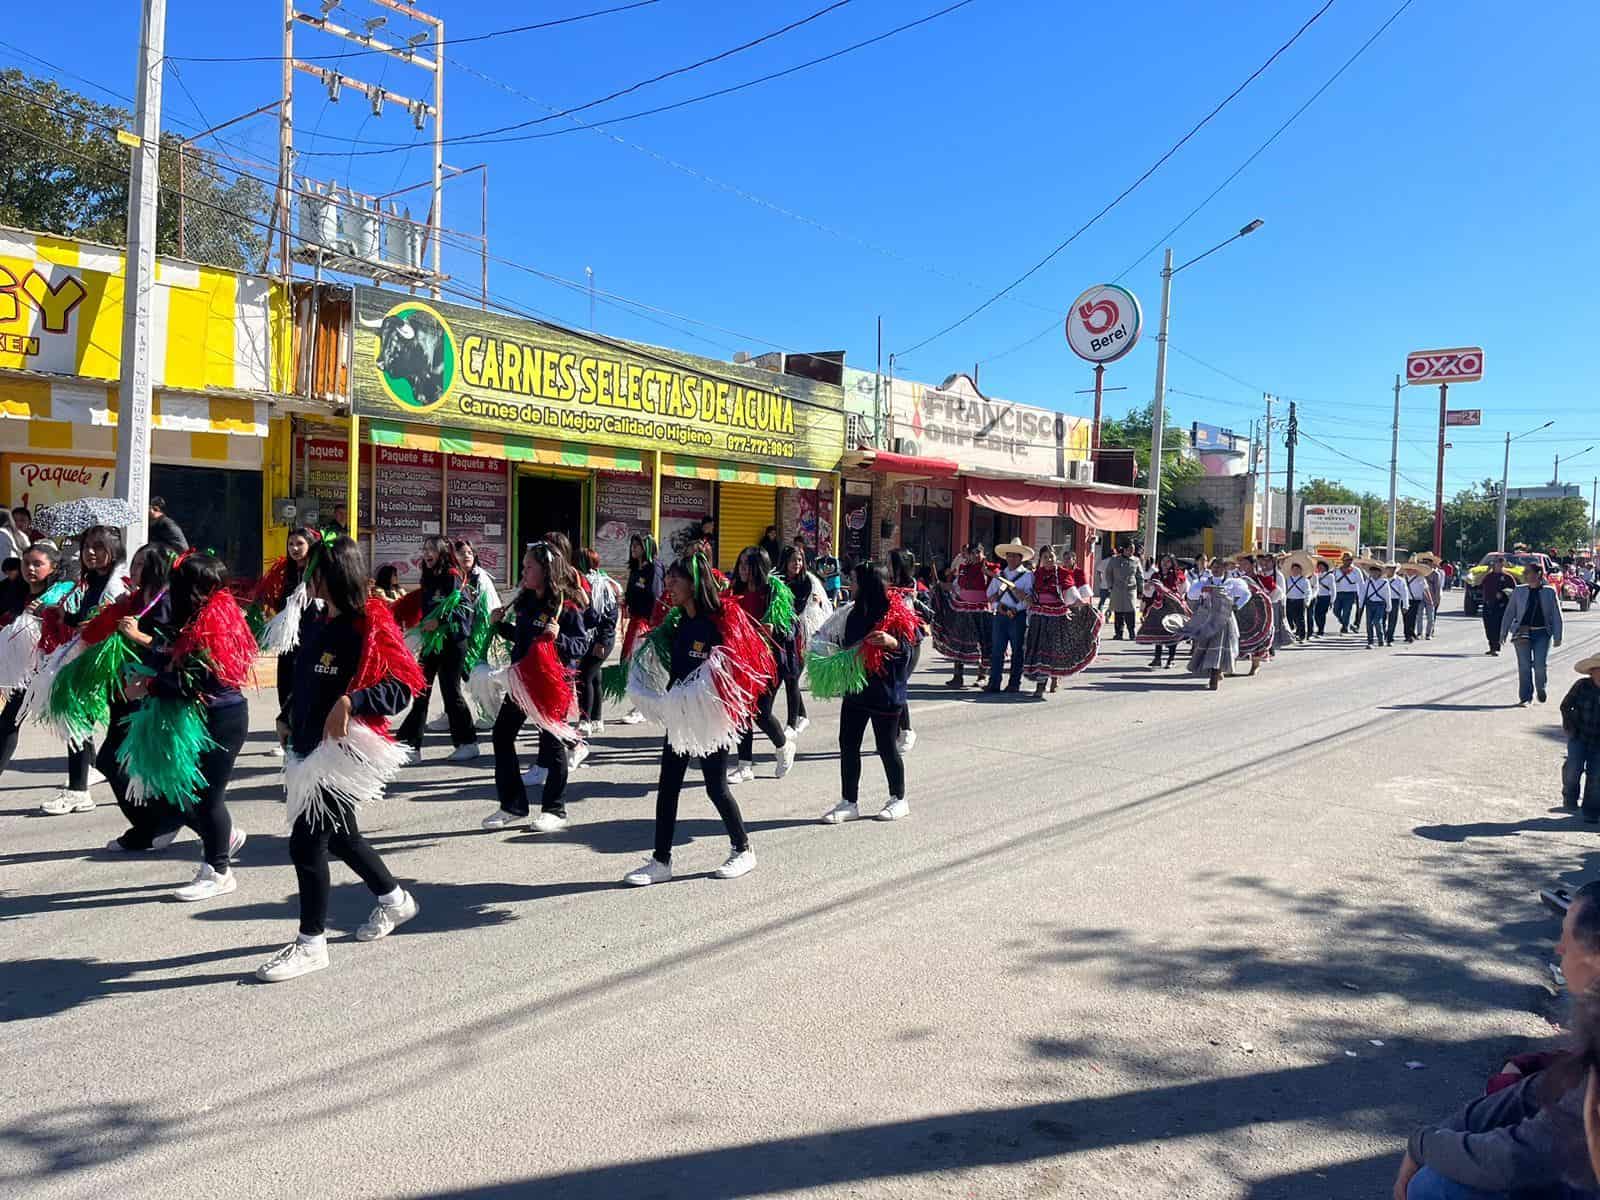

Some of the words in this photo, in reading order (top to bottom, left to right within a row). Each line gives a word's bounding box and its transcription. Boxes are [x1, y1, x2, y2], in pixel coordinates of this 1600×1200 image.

[1090, 323, 1127, 352] Berel
[1409, 354, 1480, 377] OXXO
[461, 335, 576, 401] CARNES
[579, 356, 698, 419] SELECTAS
[700, 377, 730, 425] DE
[459, 394, 518, 420] Carnes
[520, 404, 542, 424] de
[543, 407, 559, 426] la
[561, 409, 602, 433] Mejor
[604, 415, 654, 439] Calidad
[654, 425, 665, 440] e
[666, 422, 713, 446] Higiene
[925, 391, 1067, 441] FRANCISCO
[306, 446, 345, 458] aquete
[381, 448, 418, 464] Paquete
[422, 453, 434, 464] #4
[451, 455, 485, 471] Paquete
[20, 464, 93, 488] Paquete
[674, 480, 693, 490] Rica
[663, 494, 703, 505] Barbacoa
